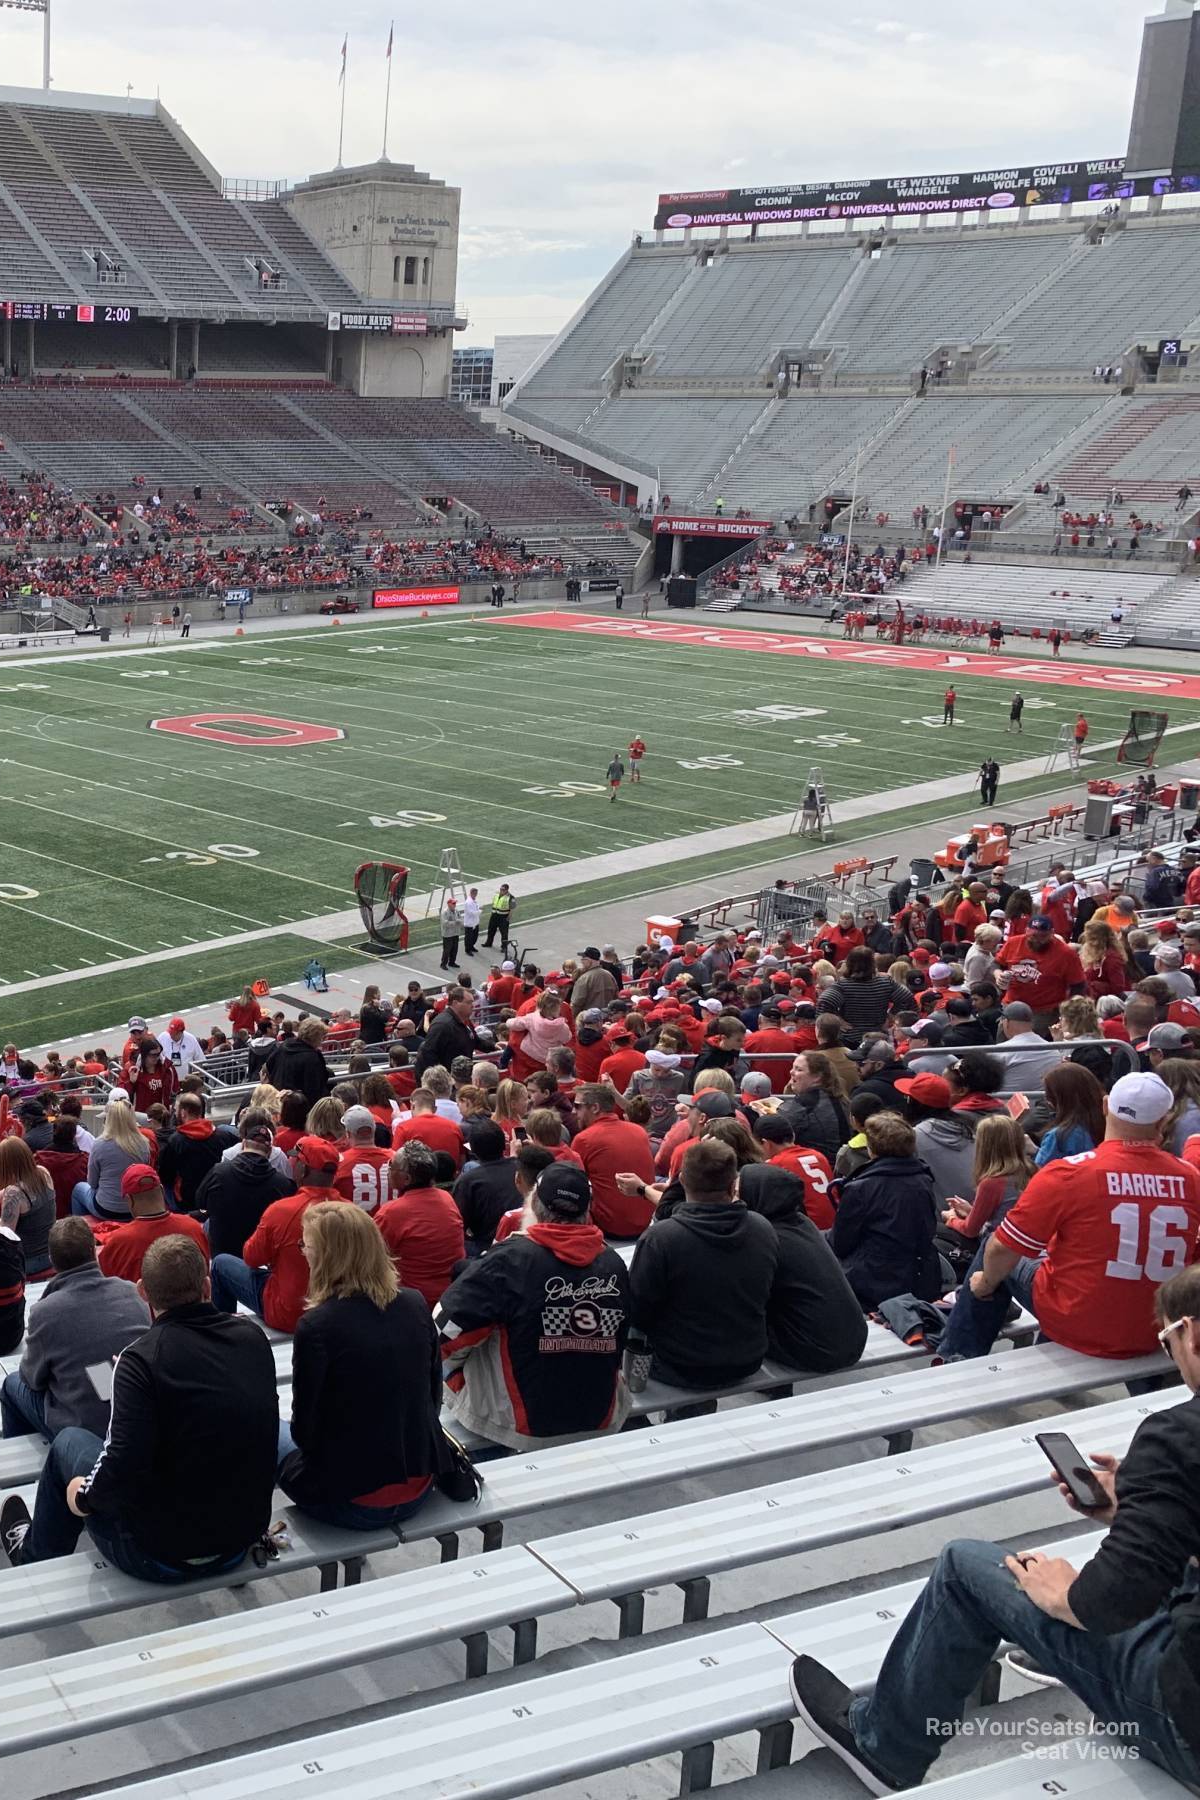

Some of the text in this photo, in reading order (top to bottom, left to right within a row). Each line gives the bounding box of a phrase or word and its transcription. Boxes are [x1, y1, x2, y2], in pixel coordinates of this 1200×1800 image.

[1033, 164, 1078, 176] COVELLI
[1086, 160, 1126, 172] WELLS
[887, 176, 960, 189] LES WEXNER
[973, 170, 1019, 183] HARMON
[994, 176, 1056, 190] WOLFE FDN
[834, 180, 871, 189] DIAMOND
[897, 185, 950, 196] WANDELL
[755, 196, 792, 206] CRONIN
[826, 192, 860, 202] McCOY
[842, 204, 896, 216] UNIVERSAL
[897, 200, 950, 212] WINDOWS
[952, 196, 986, 208] DIRECT
[693, 212, 742, 224] UNIVERSAL
[744, 209, 792, 222] WINDOWS
[793, 206, 827, 219] DIRECT
[104, 308, 130, 322] 2:00
[342, 314, 368, 325] WOODY
[368, 315, 392, 326] HAYES
[1164, 342, 1176, 354] 25
[671, 520, 700, 532] HOME
[718, 524, 767, 535] BUCKEYES
[226, 591, 246, 600] BTN
[375, 590, 459, 604] OhioStateBuckeyes.com
[578, 619, 1186, 690] BUCKEYES
[674, 754, 745, 770] 40
[520, 780, 608, 798] 50
[366, 810, 448, 829] 40
[165, 842, 262, 866] 30
[650, 928, 662, 940] G
[797, 1155, 829, 1194] 5
[1106, 1172, 1186, 1199] BARRETT
[1105, 1202, 1189, 1282] 16
[573, 1308, 598, 1330] 3
[624, 1532, 640, 1541] 16
[472, 1569, 488, 1578] 15
[312, 1608, 328, 1618] 14
[876, 1609, 895, 1621] 16
[138, 1651, 155, 1662] 13
[699, 1656, 720, 1668] 15
[512, 1706, 533, 1718] 14
[303, 1761, 324, 1774] 13
[1042, 1780, 1068, 1795] 15
